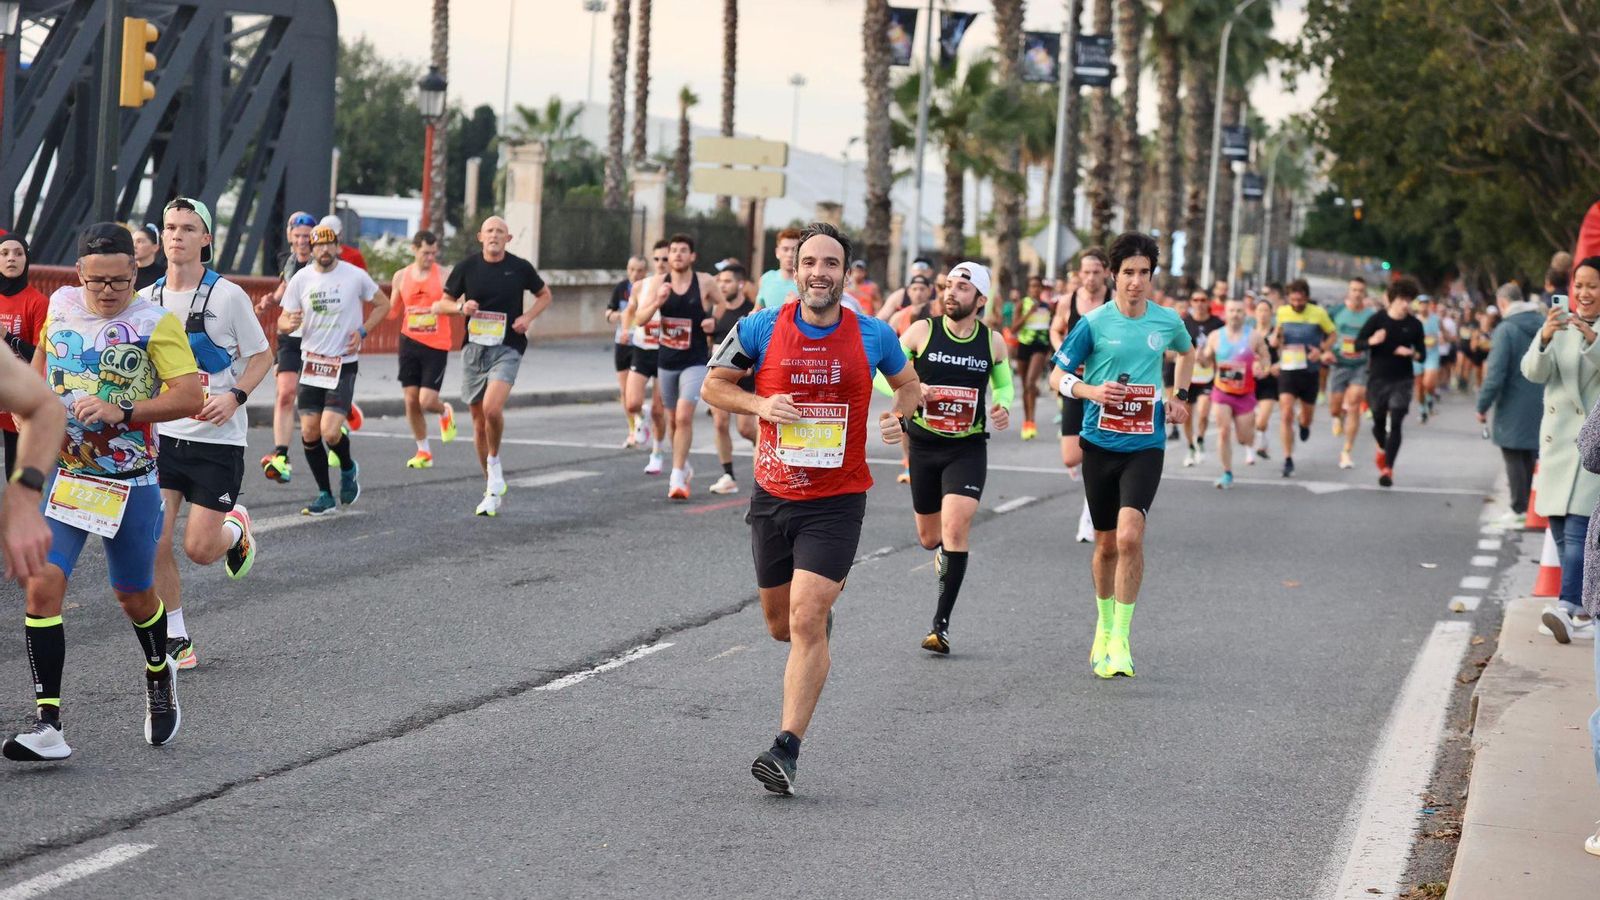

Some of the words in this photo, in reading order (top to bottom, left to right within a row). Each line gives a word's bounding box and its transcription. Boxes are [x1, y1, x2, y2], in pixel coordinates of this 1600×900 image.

[791, 359, 828, 367] GENERALI
[928, 351, 988, 369] sicurlive
[790, 372, 828, 385] MÁLAGA
[940, 388, 975, 398] GENERALI
[1126, 386, 1153, 395] ENERALI
[937, 401, 963, 413] 3743
[792, 426, 832, 439] 10319
[69, 486, 111, 506] 12277
